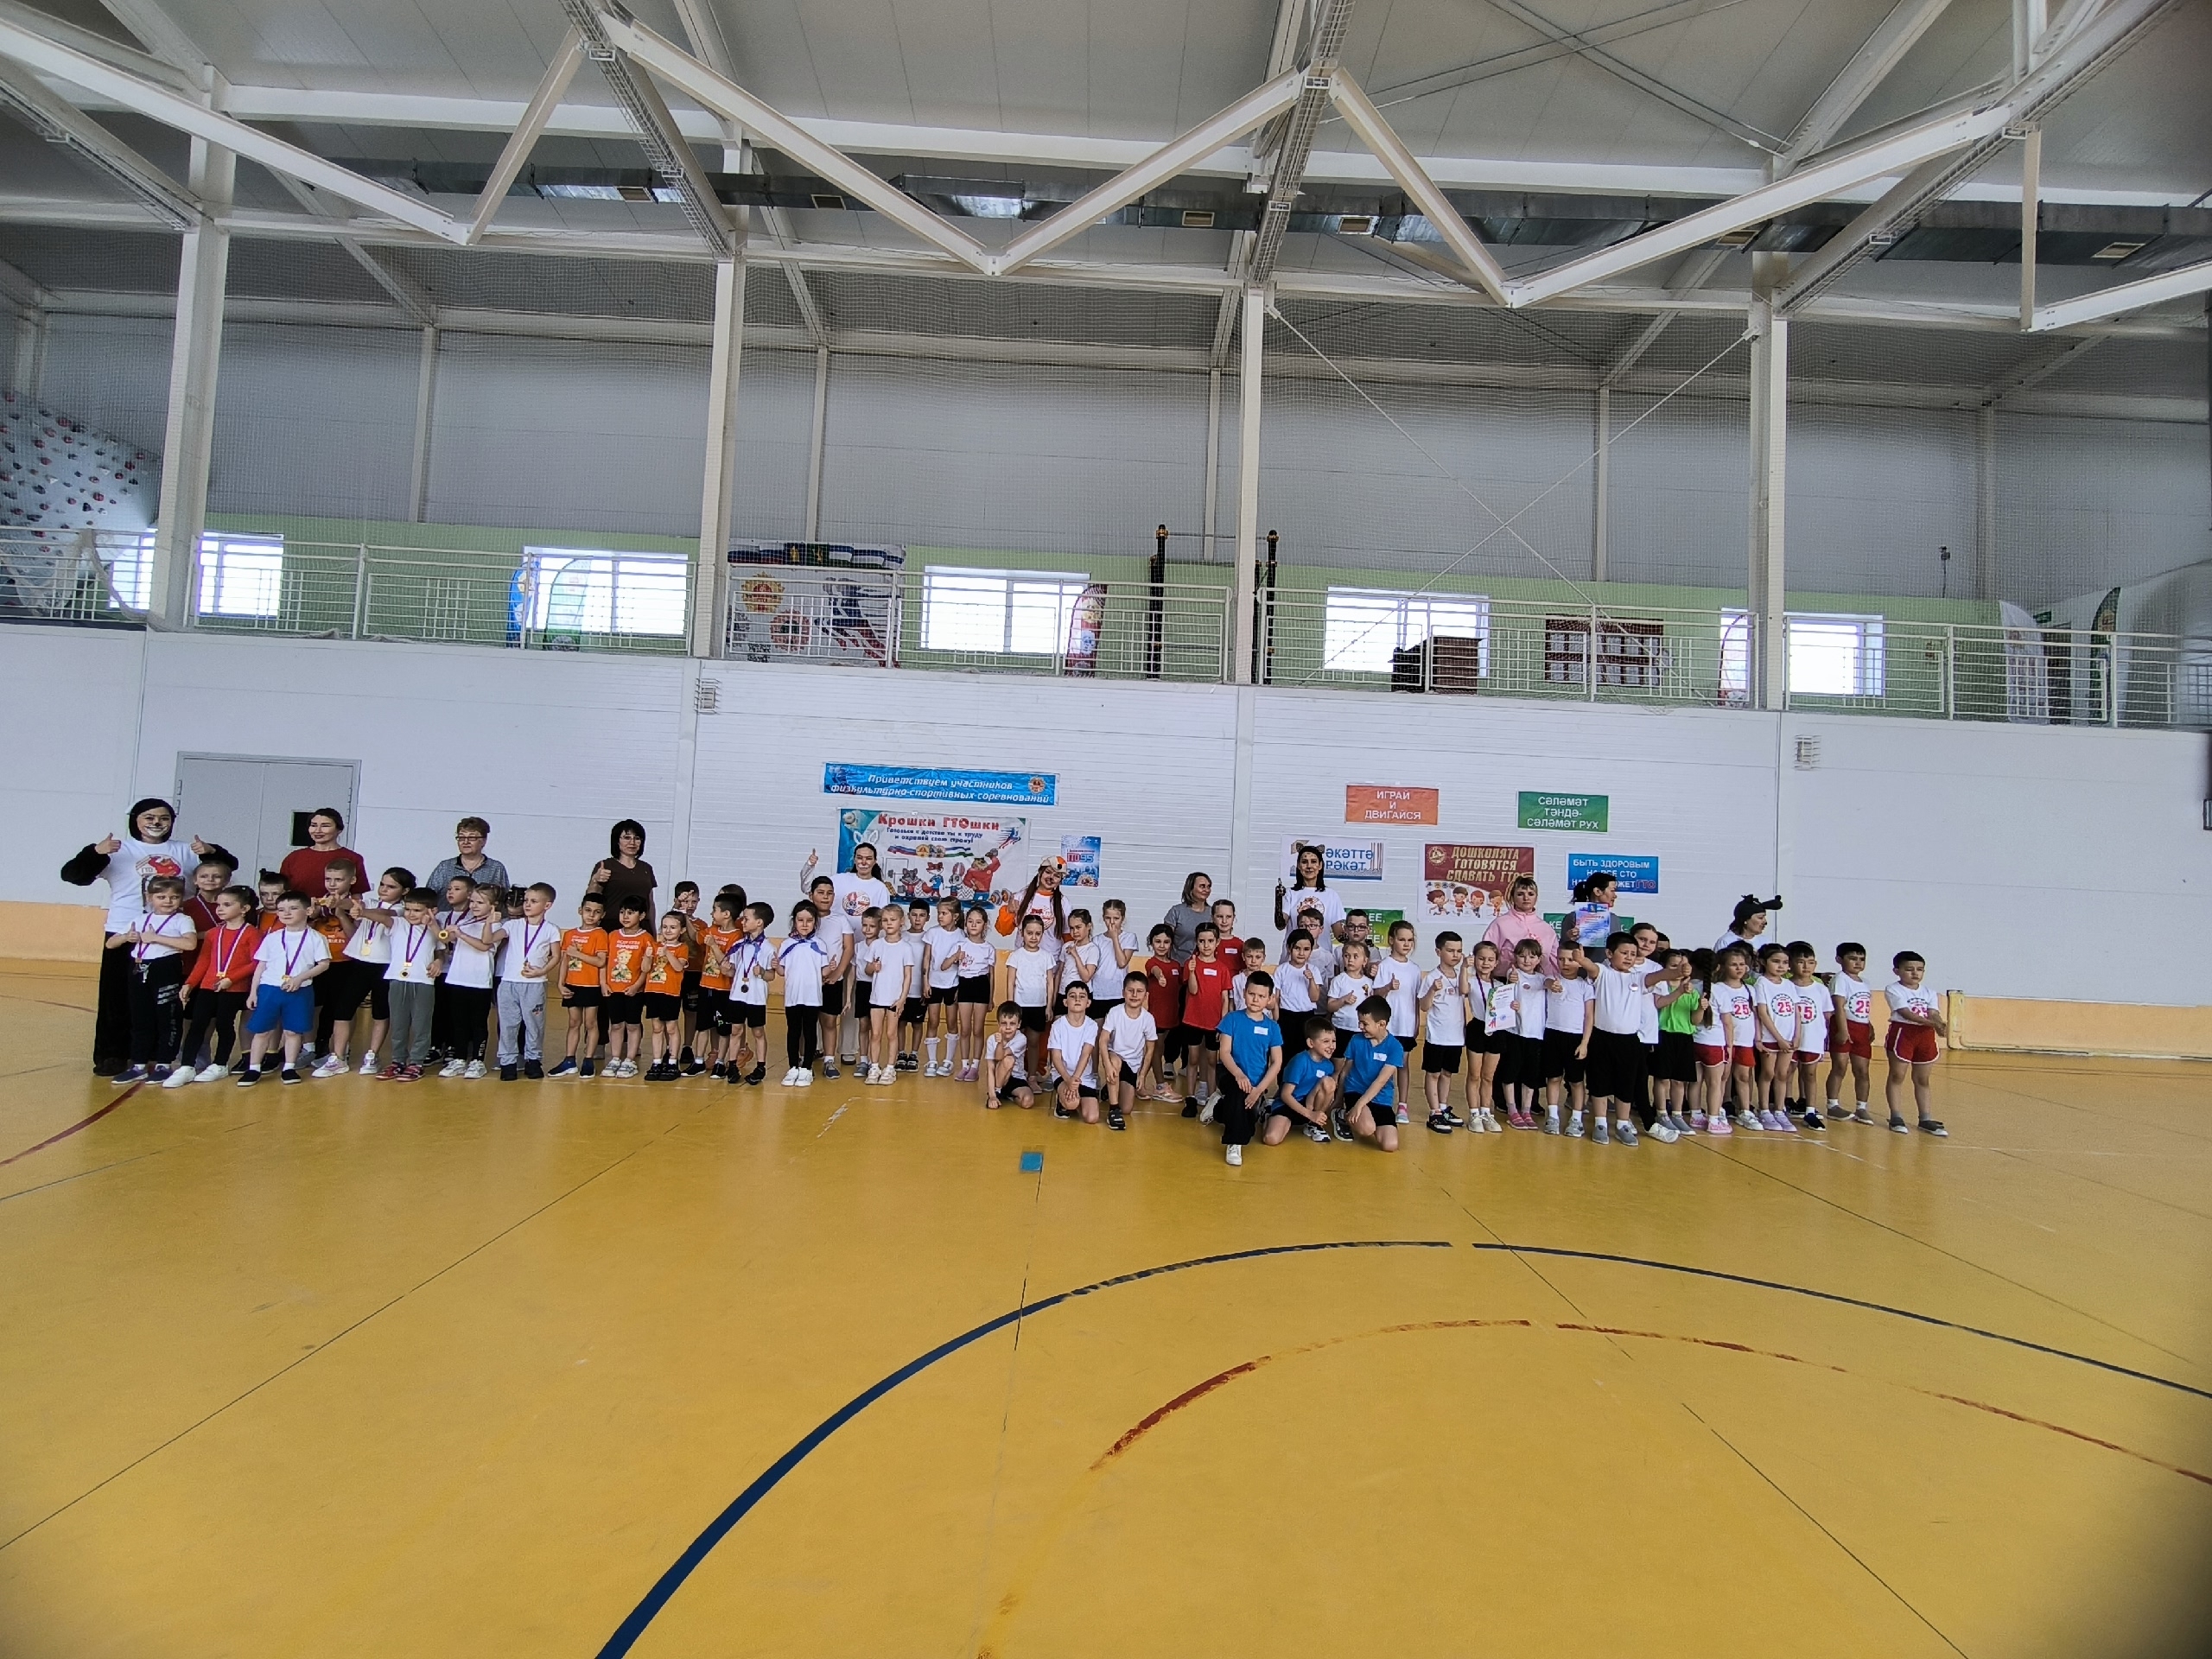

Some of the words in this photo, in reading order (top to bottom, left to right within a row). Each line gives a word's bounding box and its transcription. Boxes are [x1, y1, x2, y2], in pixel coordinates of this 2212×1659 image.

[868, 774, 947, 786] Приветствуем
[951, 779, 1012, 790] участников
[831, 785, 974, 799] физкультурно-спортивных
[977, 792, 1048, 804] соревнований
[1376, 790, 1409, 800] ИГРАЙ
[1389, 801, 1396, 810] И
[1538, 797, 1589, 807] СӘЛӘМӘТ
[1365, 810, 1421, 820] ДВИГАЙСЯ
[878, 813, 936, 827] Крошки
[943, 817, 1000, 830] ГТОшки
[1527, 817, 1578, 828] СӘЛӘМӘТ
[1579, 820, 1599, 830] РУХ
[1325, 848, 1374, 860] ӘКӘТТӘ
[1452, 847, 1520, 860] ДОШКОЛЯТА
[1325, 861, 1366, 871] РӘКӘТ
[1454, 858, 1517, 871] ГОТОВЯТСЯ
[1600, 860, 1649, 869] ЗДОРОВЫМ
[1446, 869, 1496, 882] СДАВАТЬ
[1636, 880, 1656, 889] ГТО
[1734, 1004, 1750, 1015] 25
[1777, 1001, 1792, 1014] 25
